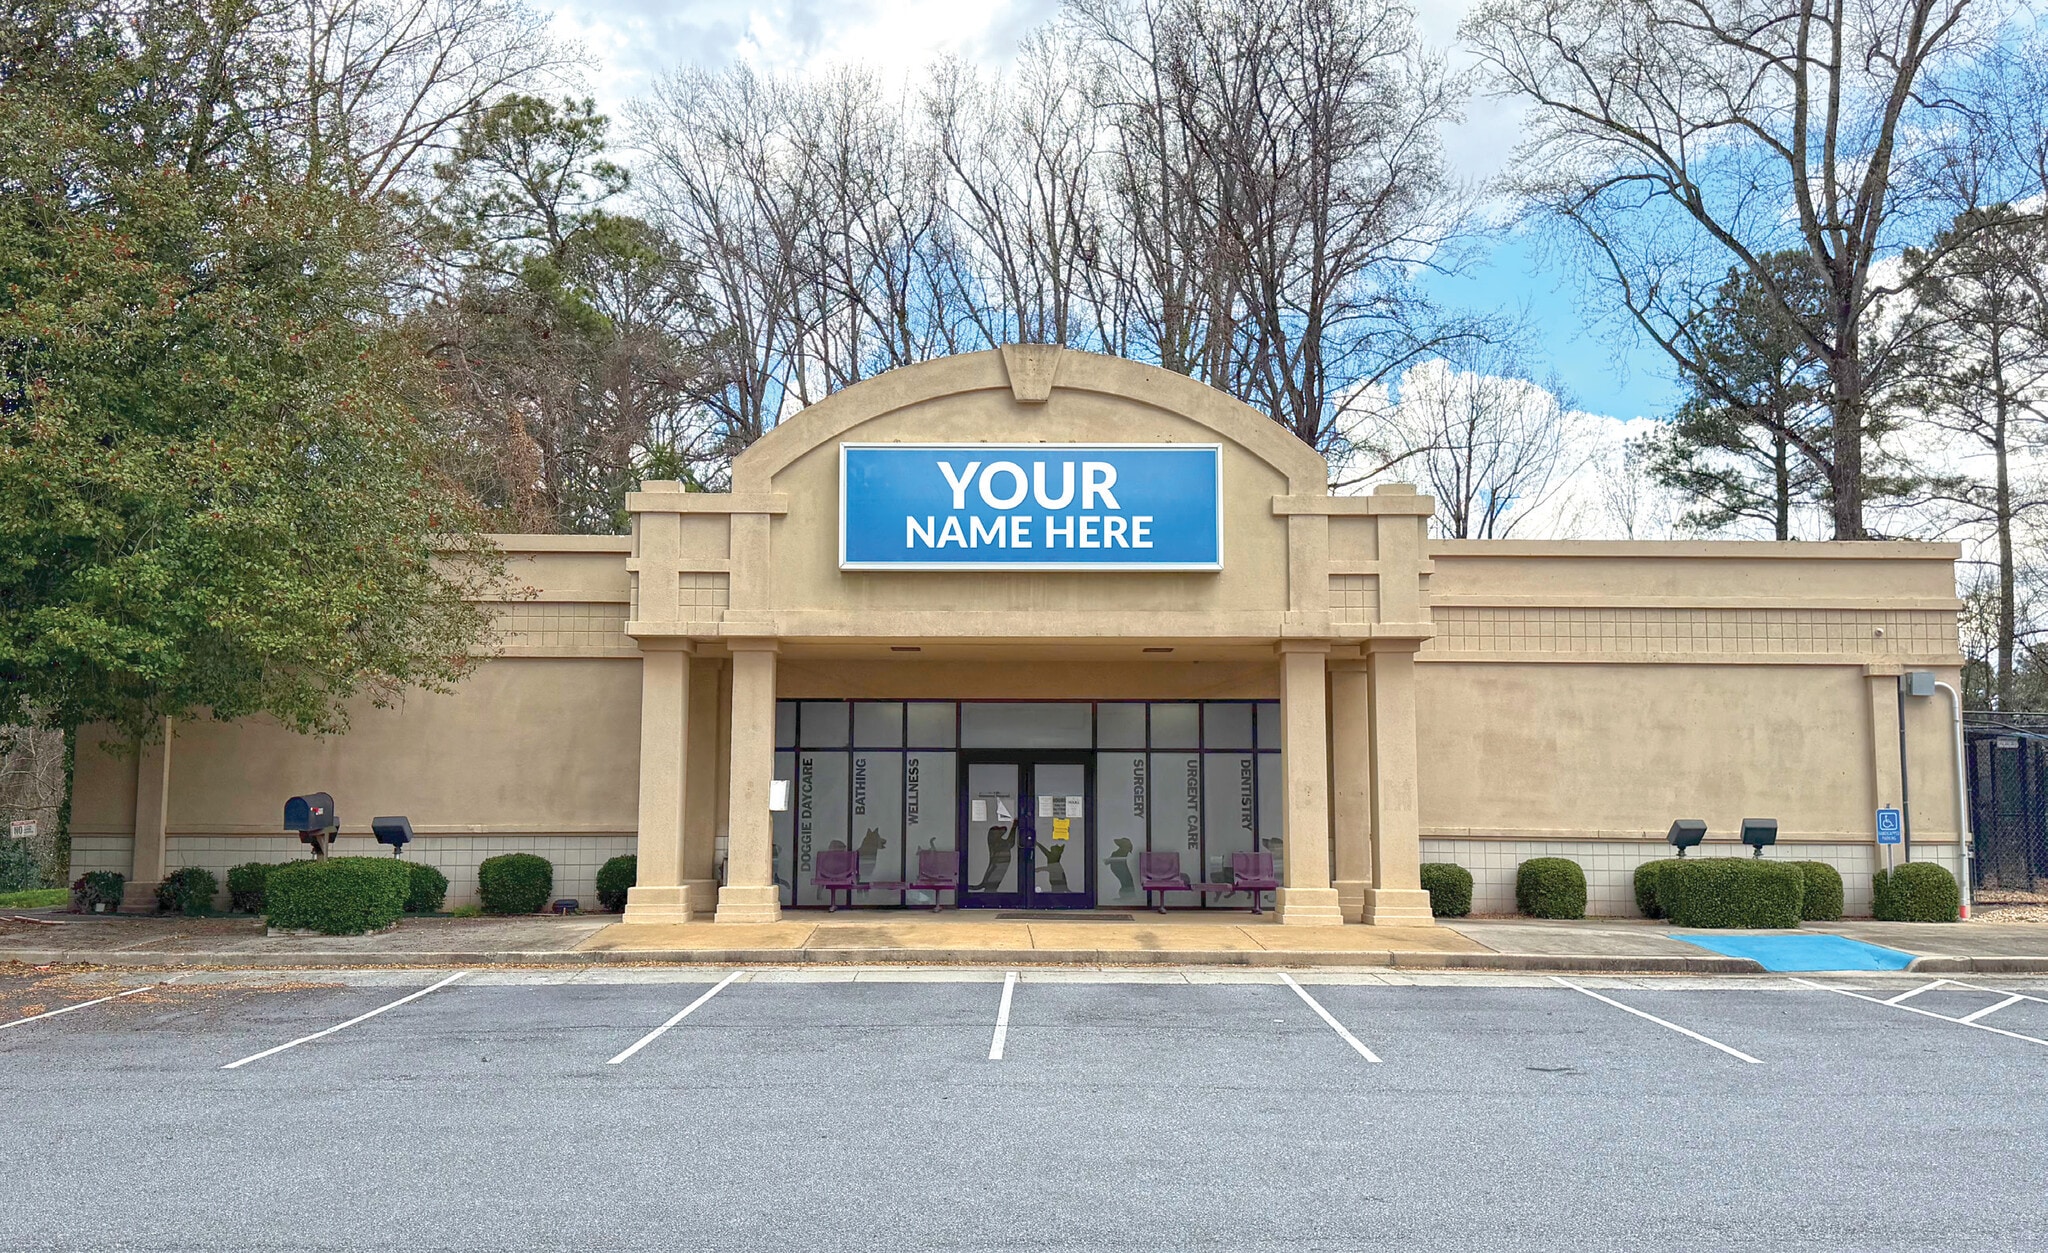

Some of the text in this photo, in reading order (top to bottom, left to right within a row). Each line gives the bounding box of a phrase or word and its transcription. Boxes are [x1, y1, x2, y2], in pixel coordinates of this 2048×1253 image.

[936, 461, 1121, 510] YOUR
[906, 515, 1154, 549] NAME HERE
[801, 758, 813, 872] DOGGIE DAYCARE
[855, 758, 866, 815] BATHING
[908, 758, 919, 826] WELLNESS
[1133, 759, 1144, 819] SURGERY
[1187, 759, 1198, 850] URGENT CARE
[1240, 759, 1252, 832] DENTISTRY
